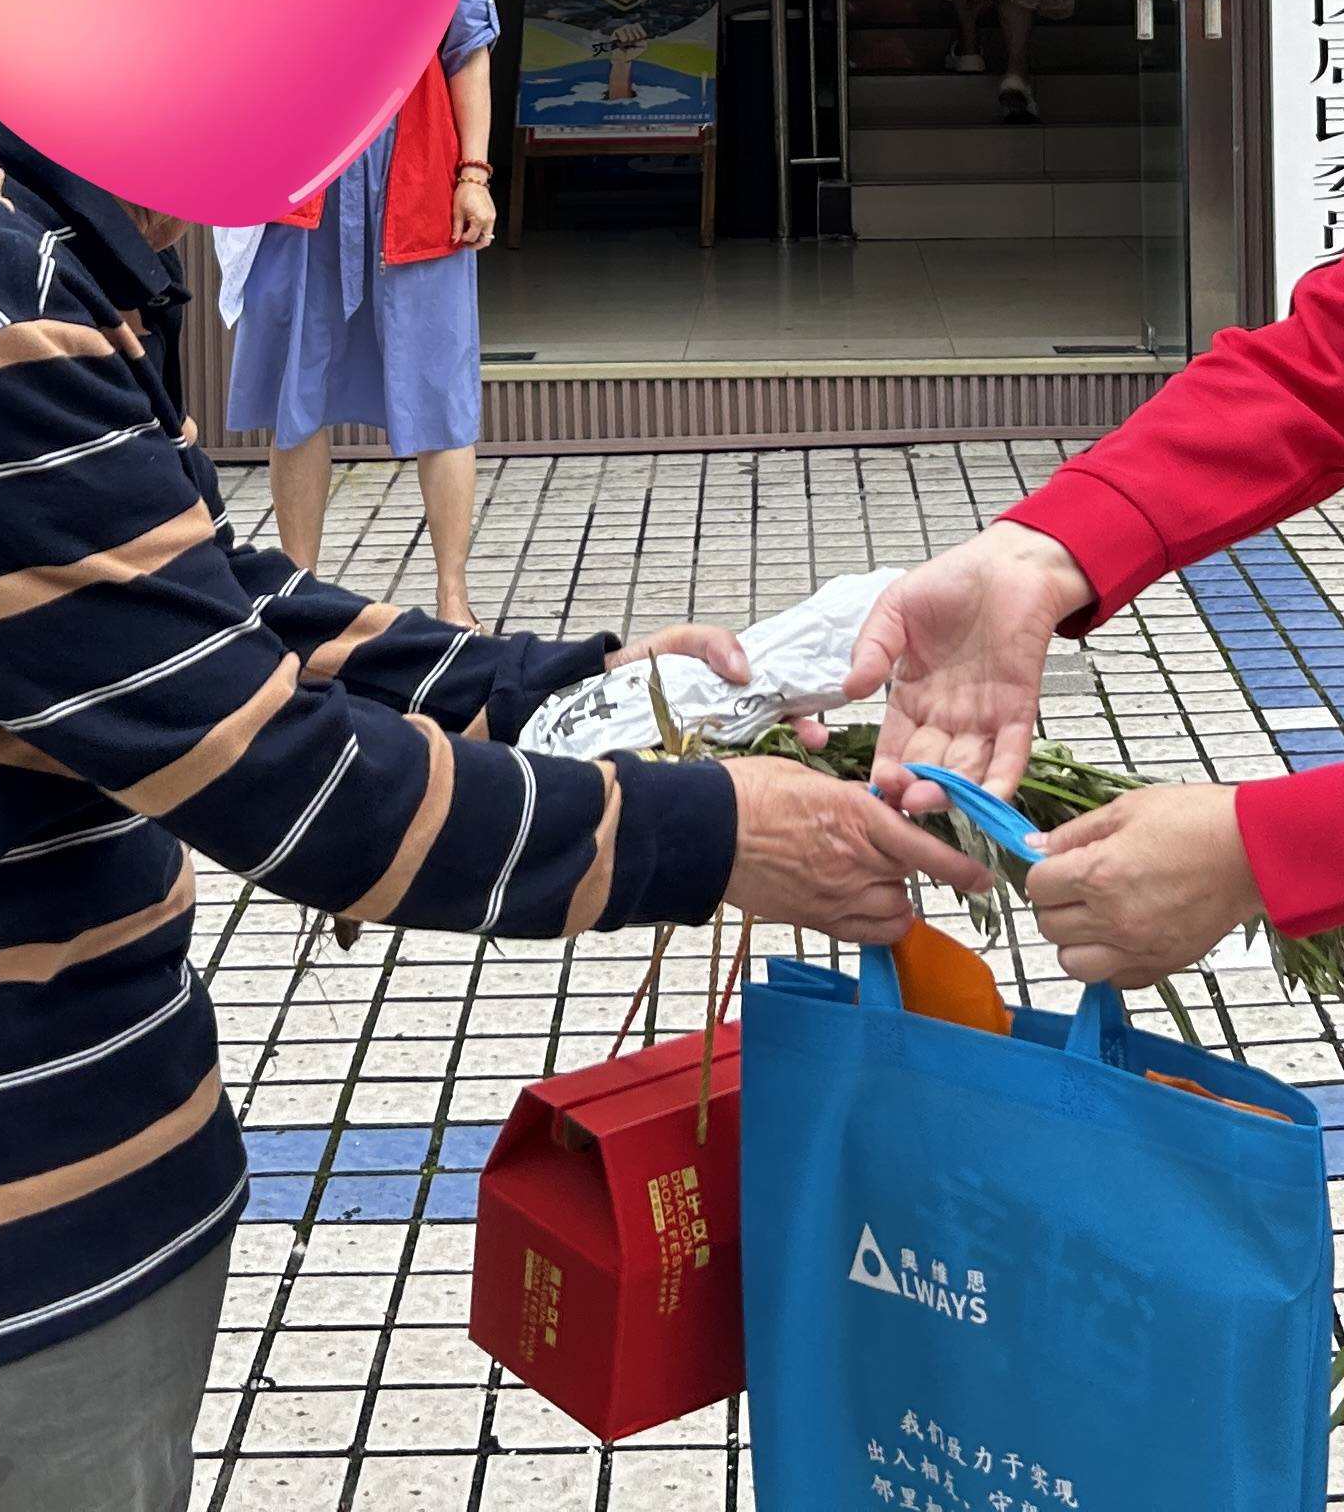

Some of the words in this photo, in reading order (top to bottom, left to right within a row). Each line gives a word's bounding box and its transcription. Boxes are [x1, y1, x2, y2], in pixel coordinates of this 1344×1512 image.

[658, 1173, 677, 1226] BOAT
[670, 1169, 694, 1256] DRAGON
[899, 1408, 1079, 1509] 我们致力于实现
